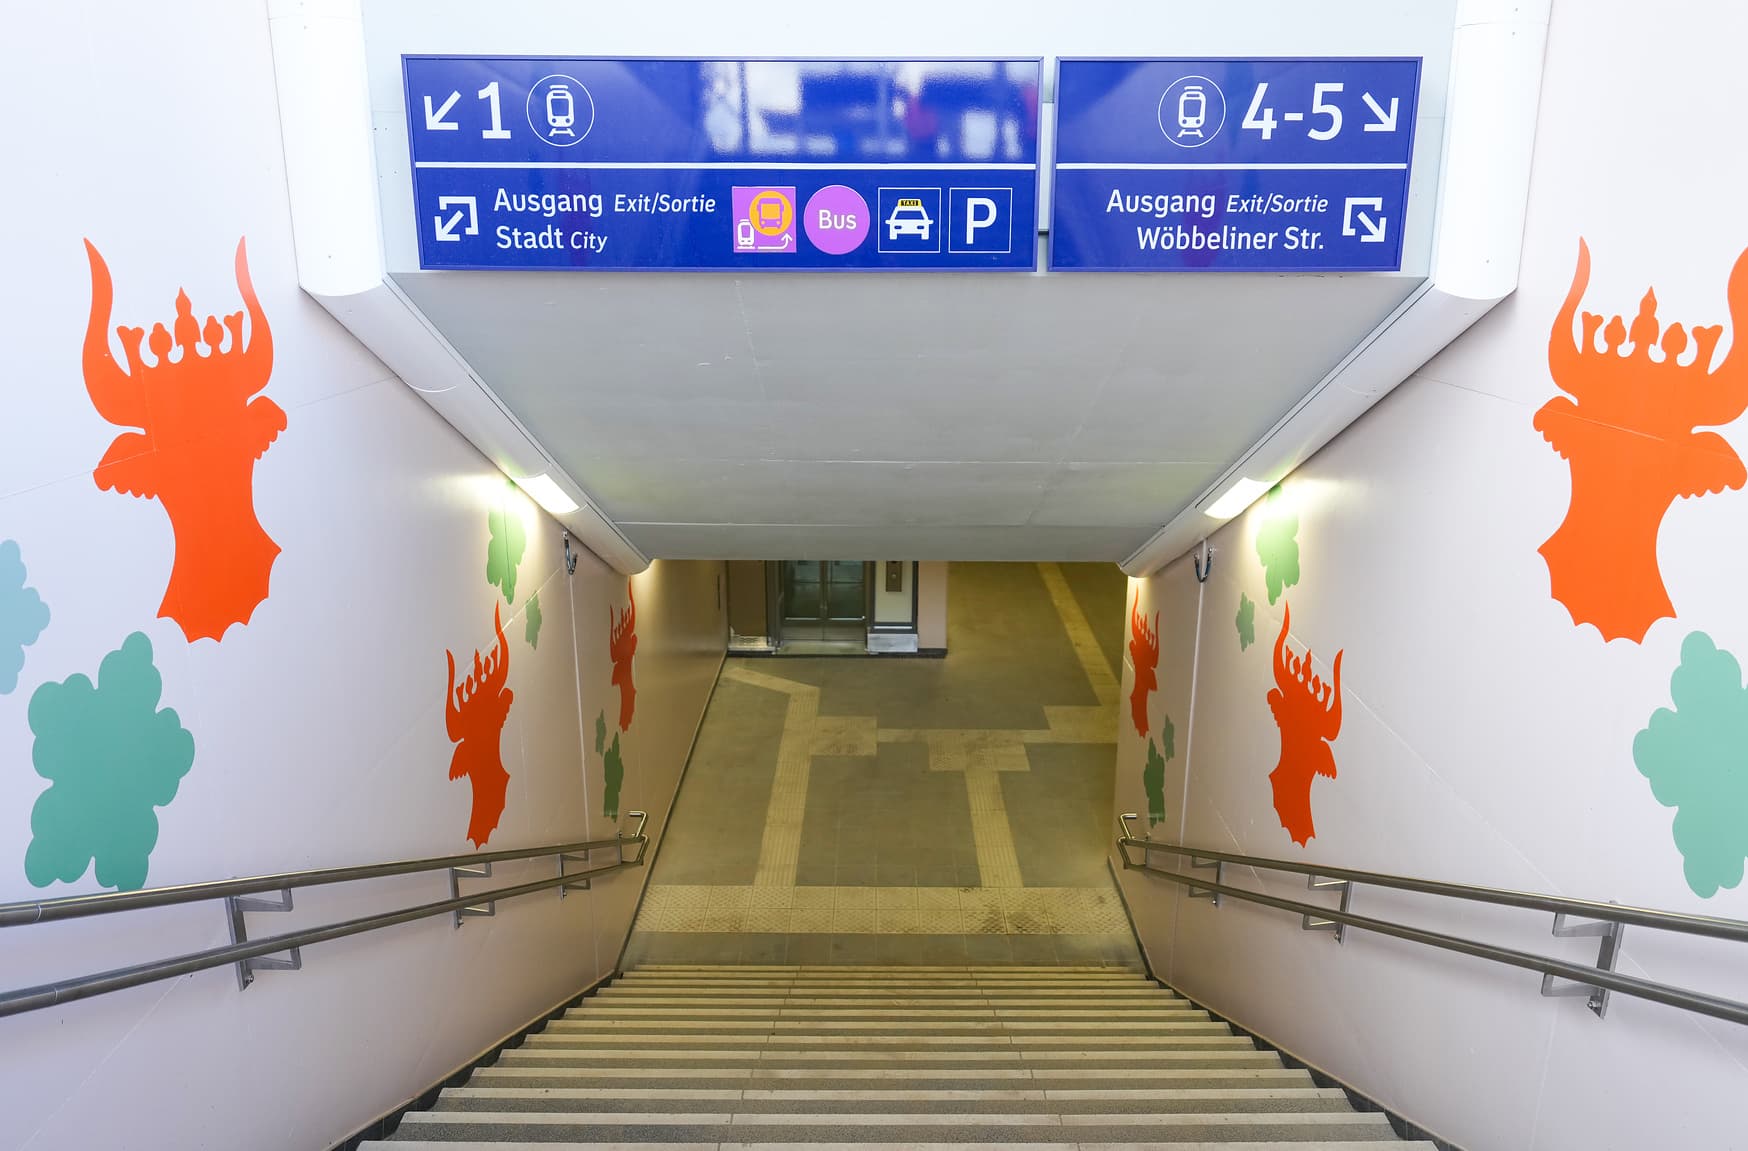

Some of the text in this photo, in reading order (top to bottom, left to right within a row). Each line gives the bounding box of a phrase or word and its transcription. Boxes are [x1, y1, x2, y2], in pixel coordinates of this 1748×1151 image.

[478, 81, 511, 139] 1
[1241, 82, 1344, 141] 4-5
[494, 188, 716, 217] Ausgang Exit/Sortie
[1106, 189, 1328, 218] Ausgang Exit/Sortie
[818, 209, 857, 230] Bus
[966, 197, 997, 245] P
[496, 225, 608, 253] Stadt City
[1137, 225, 1324, 250] Wöbbeliner Str.
